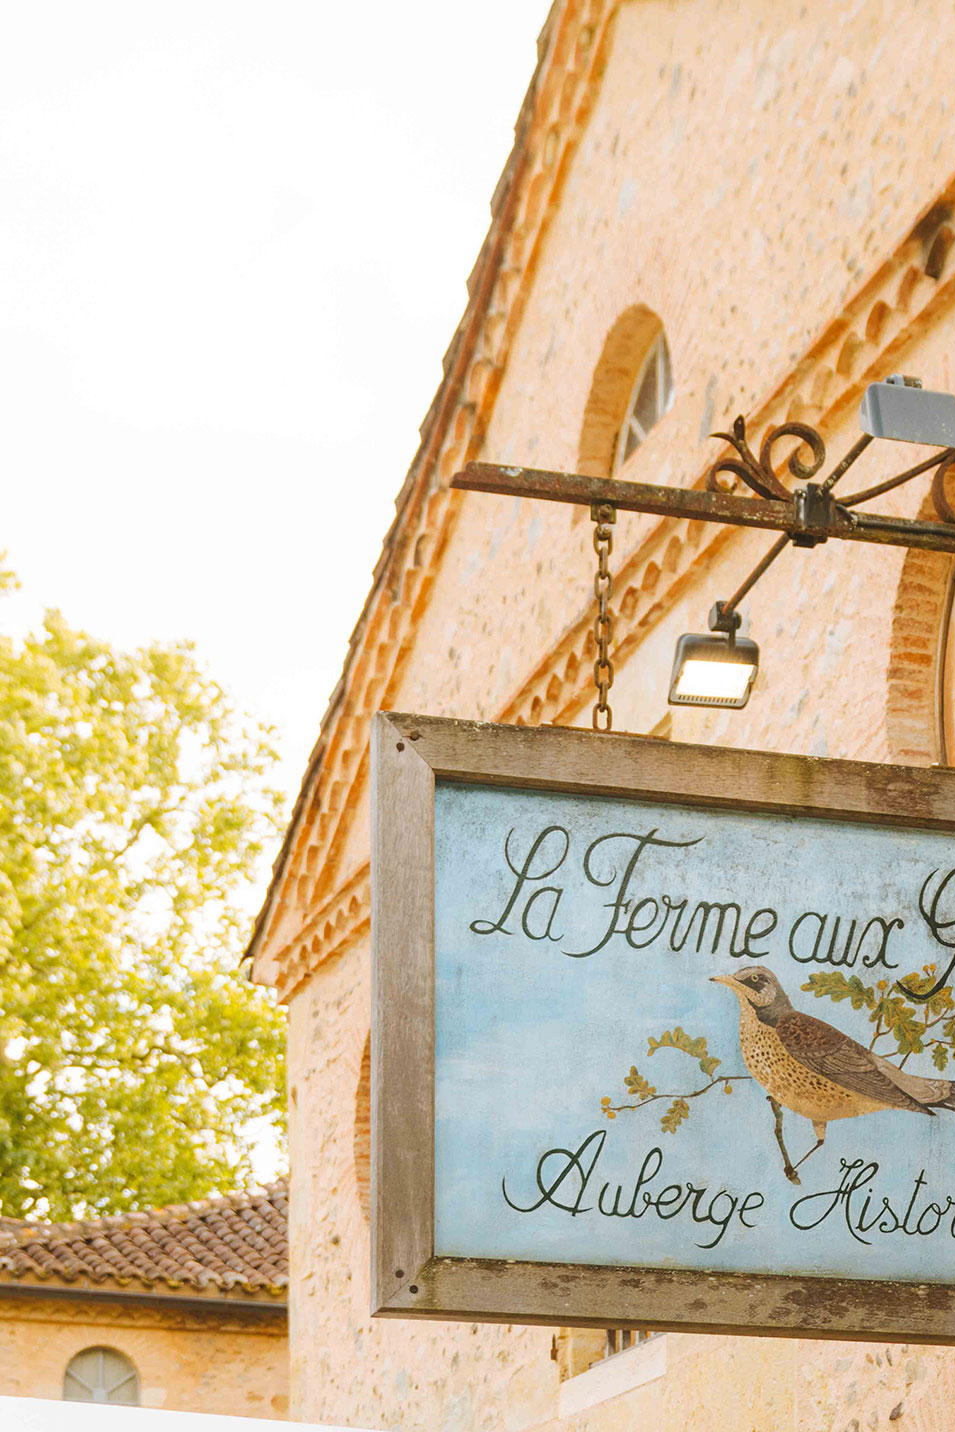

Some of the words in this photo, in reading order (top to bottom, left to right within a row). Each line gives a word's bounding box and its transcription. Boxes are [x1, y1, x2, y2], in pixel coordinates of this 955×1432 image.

[469, 826, 570, 942] La
[561, 828, 778, 958] Ferme
[789, 910, 904, 969] aux
[502, 1129, 765, 1249] Auberge
